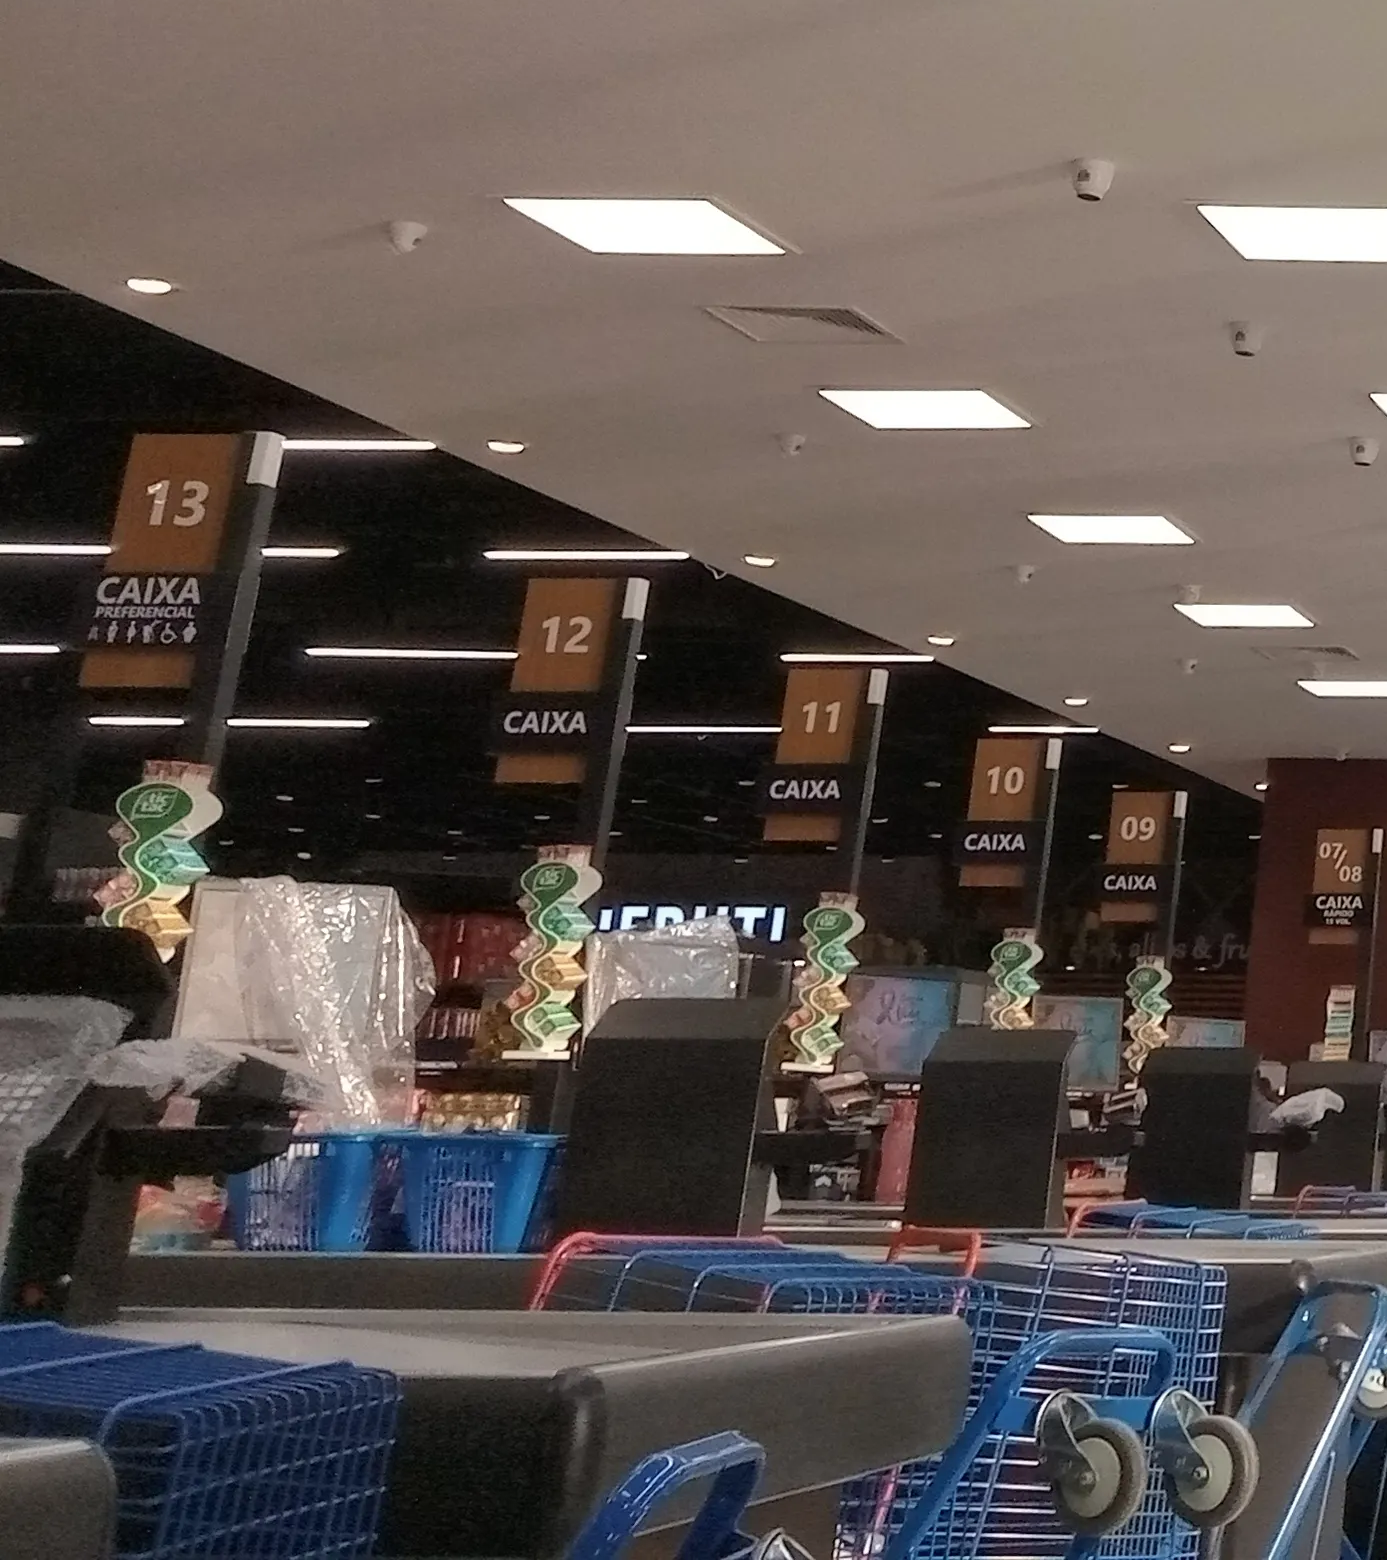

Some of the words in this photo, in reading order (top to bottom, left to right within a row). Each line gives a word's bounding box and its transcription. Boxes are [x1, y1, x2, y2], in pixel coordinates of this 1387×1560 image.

[146, 480, 209, 527] 13
[96, 576, 201, 605] CAIXA
[93, 606, 196, 619] PREFERENCIAL
[542, 616, 593, 654] 12
[503, 711, 587, 734] CAIXA
[802, 701, 841, 733] 11
[769, 779, 841, 799] CAIXA
[987, 766, 1025, 795] 10
[1120, 816, 1156, 841] 09
[964, 833, 1026, 851] CAIXA
[1103, 875, 1157, 891] CAIXA
[1316, 895, 1363, 909] CAIXA
